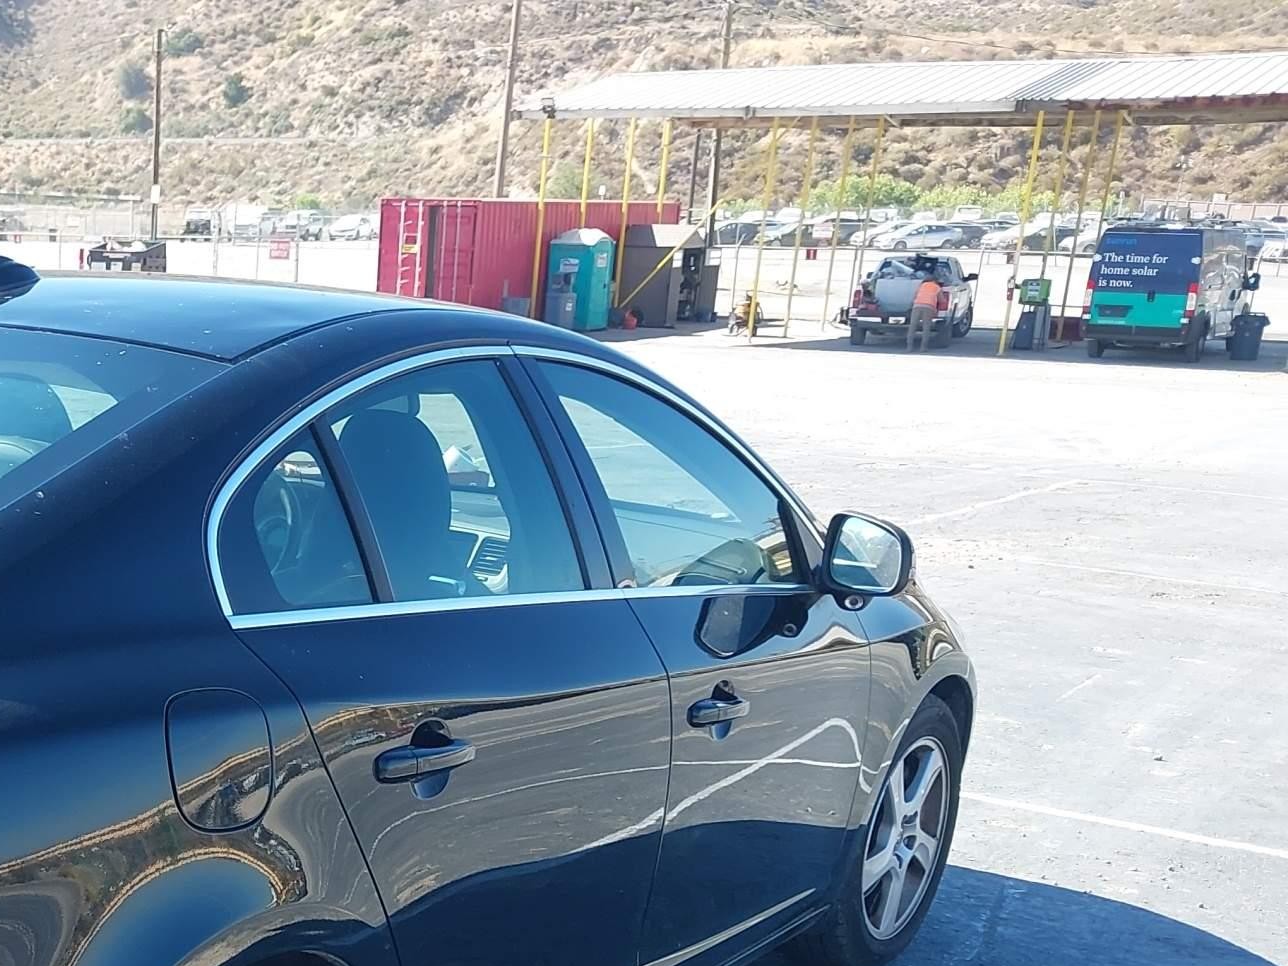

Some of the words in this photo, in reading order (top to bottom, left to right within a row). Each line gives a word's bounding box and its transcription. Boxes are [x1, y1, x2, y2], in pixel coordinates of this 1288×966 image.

[1103, 252, 1124, 262] The
[1126, 253, 1150, 263] time
[1152, 254, 1169, 264] for
[1100, 265, 1130, 275] home
[1131, 266, 1159, 276] solar
[1098, 276, 1108, 287] is
[1109, 279, 1133, 288] now.
